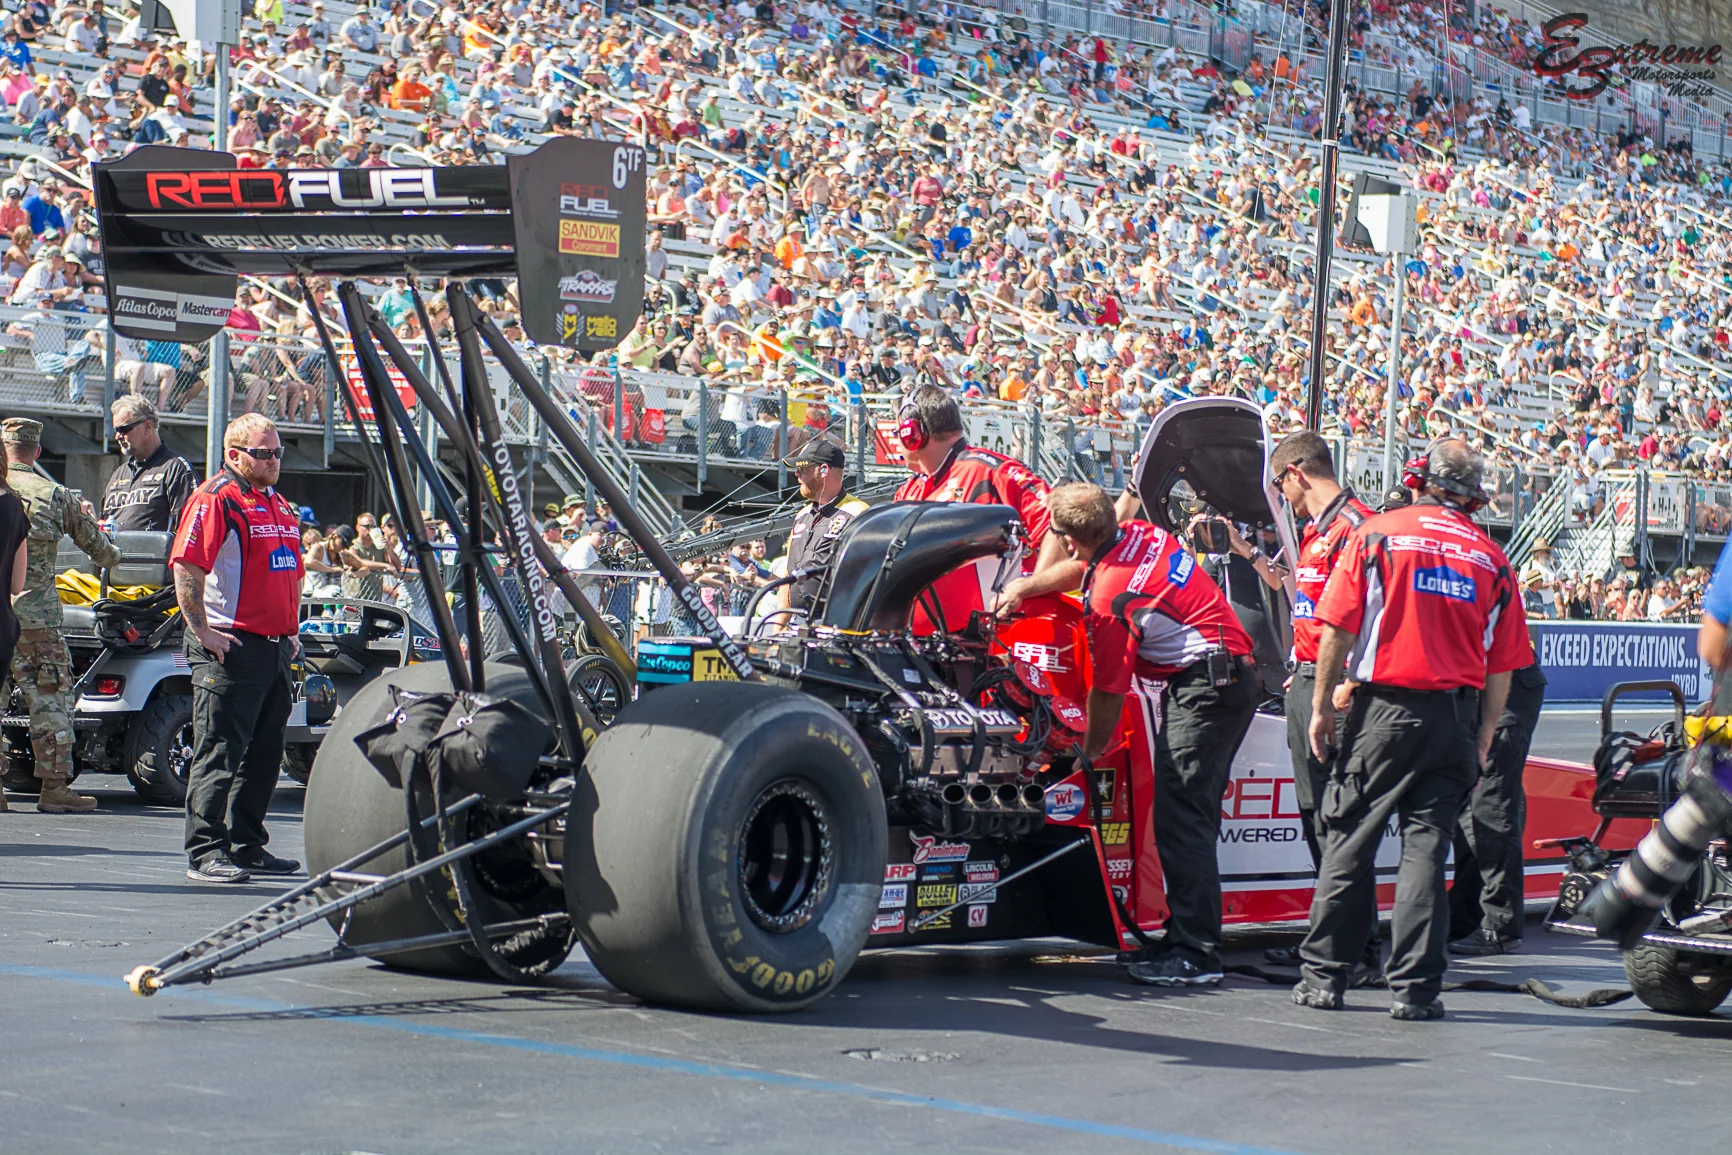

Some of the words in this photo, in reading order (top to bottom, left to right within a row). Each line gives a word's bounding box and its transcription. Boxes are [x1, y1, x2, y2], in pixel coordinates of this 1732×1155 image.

[146, 171, 286, 208] RED
[287, 169, 469, 208] FUEL
[560, 182, 609, 200] RED
[560, 195, 618, 214] FUEL
[561, 222, 617, 243] SANDVIK
[571, 240, 608, 253] Coromant
[557, 279, 618, 296] TRAXXAS
[115, 299, 148, 315] Atlas
[147, 302, 177, 319] Copco
[181, 302, 232, 319] Mastercam
[104, 486, 160, 511] ARMY
[491, 438, 556, 643] TOYOTARACING.COM
[1540, 632, 1590, 667] EXCEED
[1592, 634, 1697, 668] EXPECTATIONS...
[945, 710, 1017, 726] TOOTA
[1060, 707, 1082, 719] MSD
[1101, 823, 1131, 845] EGS
[965, 864, 993, 873] LINCOLN
[919, 885, 955, 900] BULLET
[971, 908, 985, 922] CV
